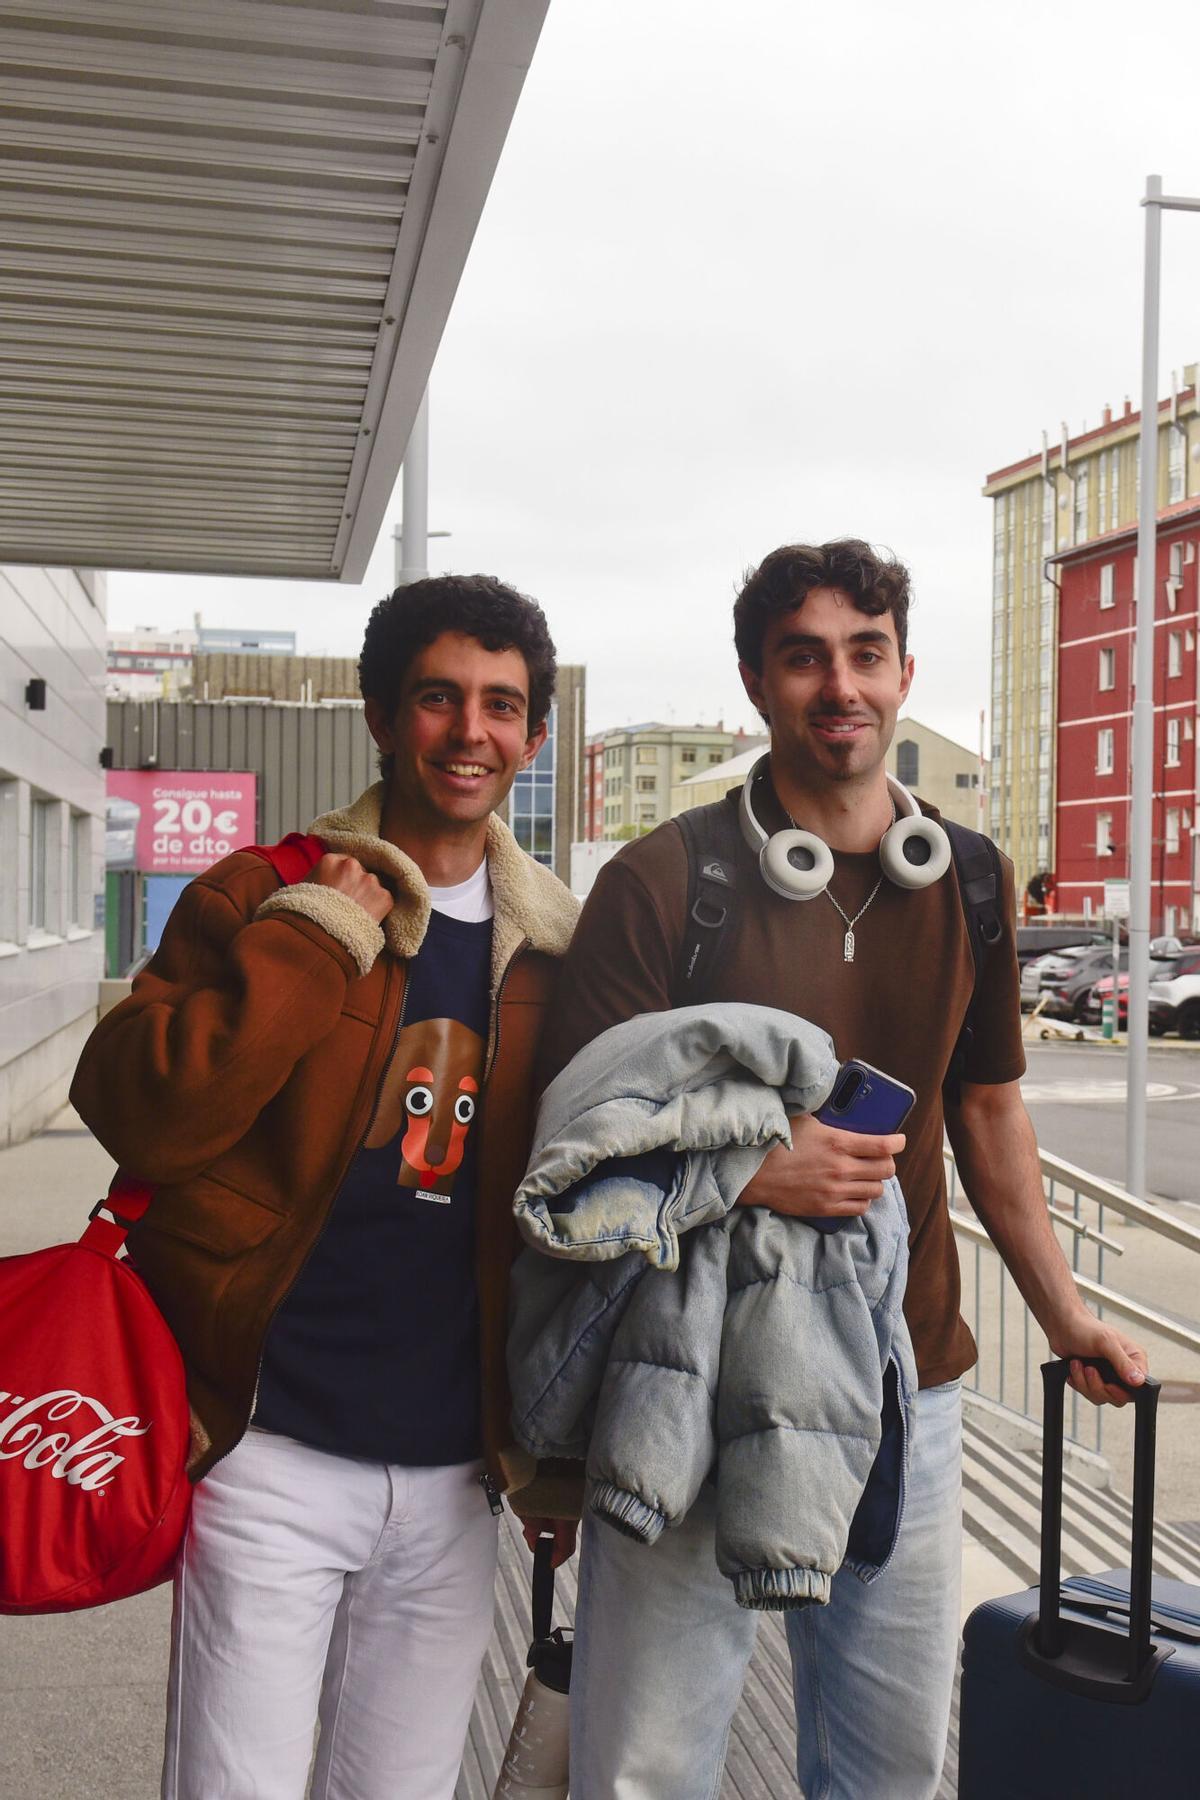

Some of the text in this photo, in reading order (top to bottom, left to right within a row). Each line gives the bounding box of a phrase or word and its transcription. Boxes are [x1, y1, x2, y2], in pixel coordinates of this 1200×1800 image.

[152, 787, 242, 799] Consigue hasta
[153, 800, 239, 834] 20€
[152, 835, 235, 854] de dto.
